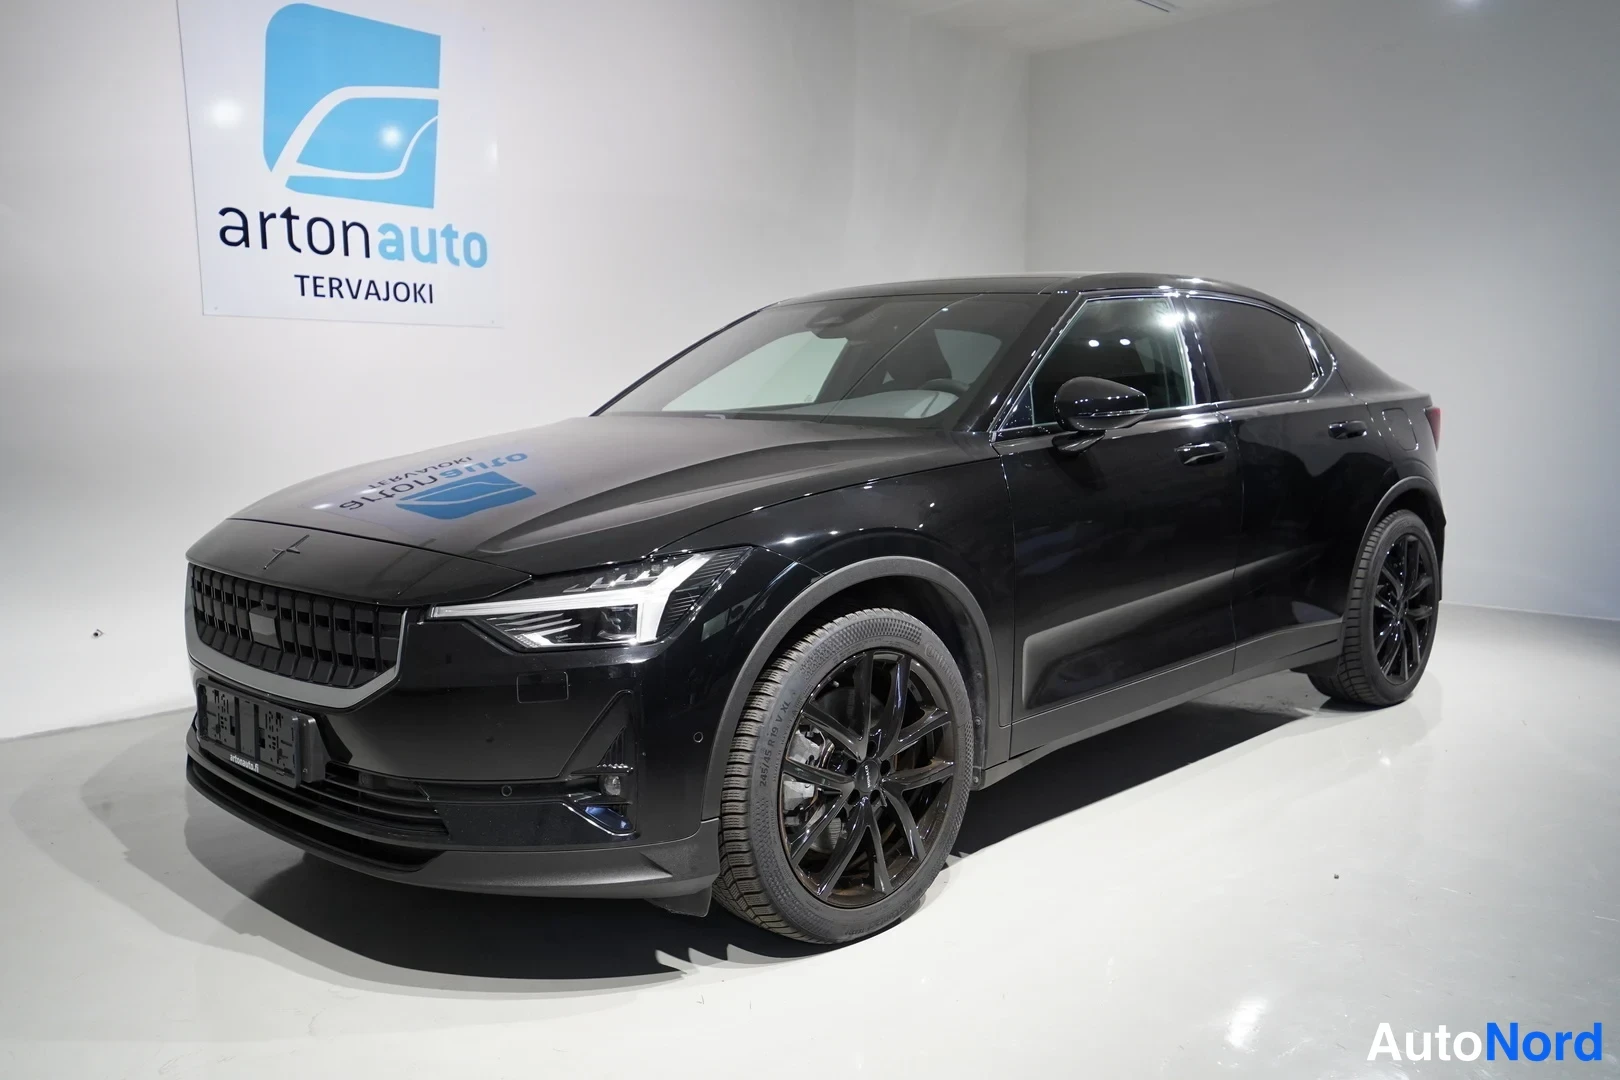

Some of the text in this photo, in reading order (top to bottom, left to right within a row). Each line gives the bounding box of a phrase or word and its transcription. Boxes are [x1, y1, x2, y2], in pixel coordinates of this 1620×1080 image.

[218, 206, 488, 268] artonauto
[294, 274, 433, 304] TERVAJOKI
[230, 754, 259, 773] artonauto.fi
[760, 701, 791, 787] 245/45 R 19 V XL
